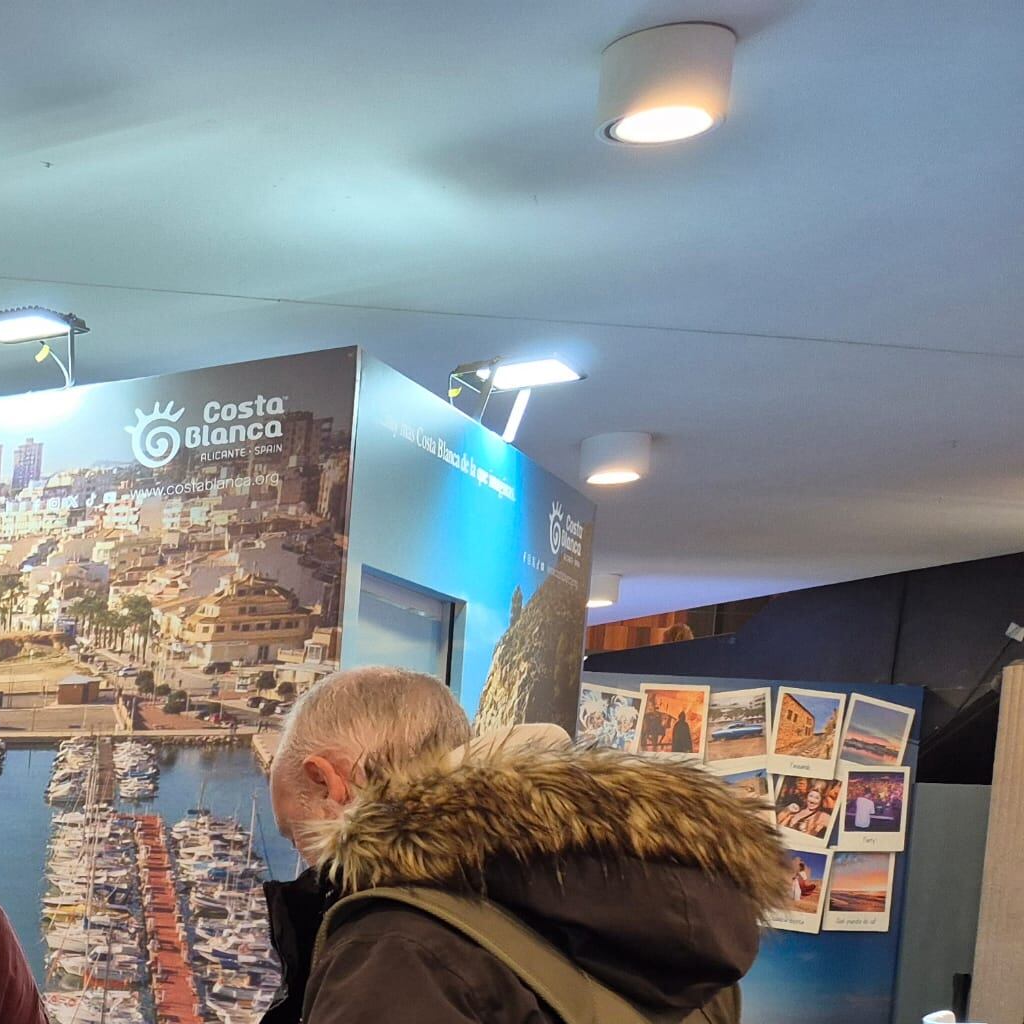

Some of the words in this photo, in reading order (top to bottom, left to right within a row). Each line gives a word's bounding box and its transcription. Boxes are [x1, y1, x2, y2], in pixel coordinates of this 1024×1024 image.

[203, 394, 285, 424] Costa
[184, 419, 284, 449] Blanca
[200, 449, 246, 462] ALICANTE
[254, 444, 283, 456] SPAIN
[416, 427, 436, 455] Costa
[437, 437, 461, 469] Blanca
[461, 452, 470, 474] de
[129, 472, 279, 498] www.costablanca.org
[565, 513, 583, 540] Costa
